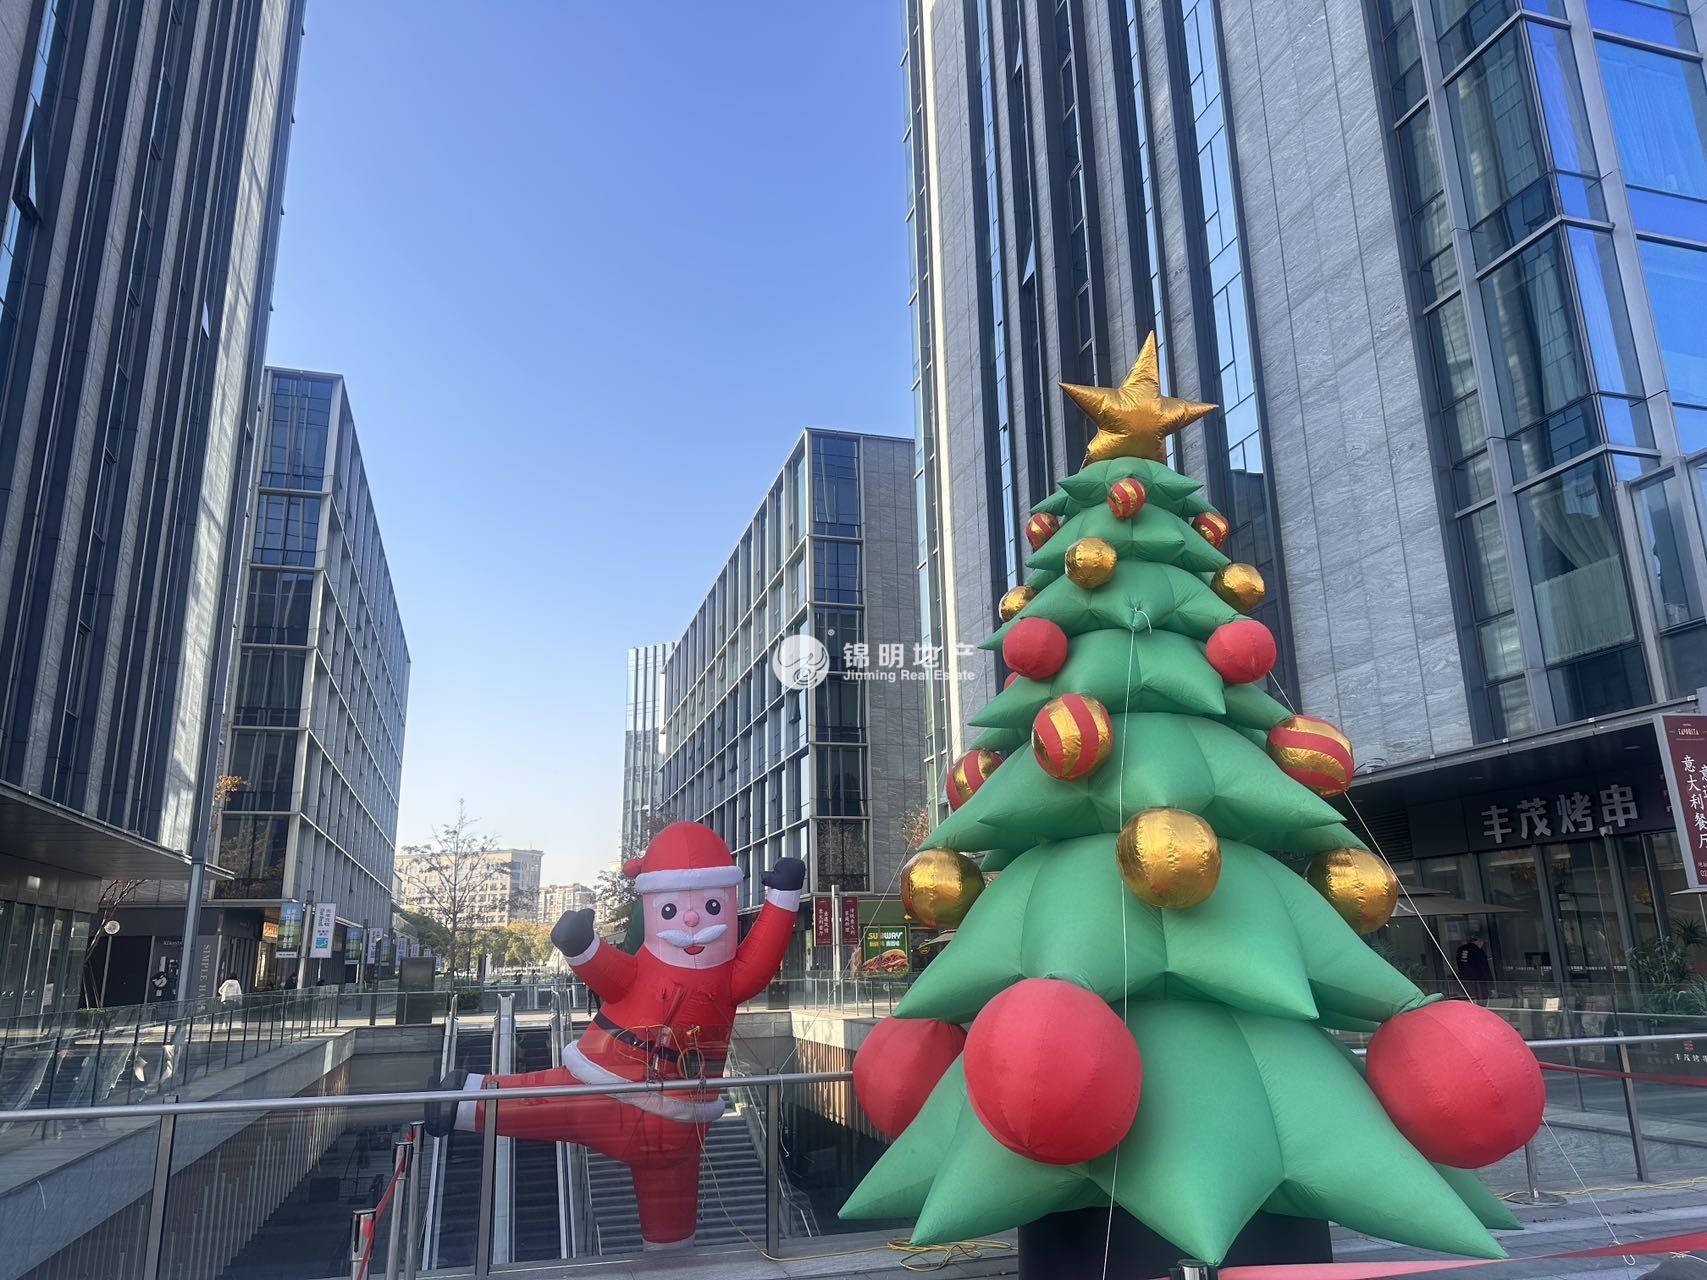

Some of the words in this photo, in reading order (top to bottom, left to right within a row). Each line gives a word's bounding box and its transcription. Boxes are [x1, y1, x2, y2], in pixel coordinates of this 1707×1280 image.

[1481, 784, 1638, 844] 丰茂烤串
[867, 931, 903, 940] SUBWAY
[200, 944, 211, 982] SIMPLE
